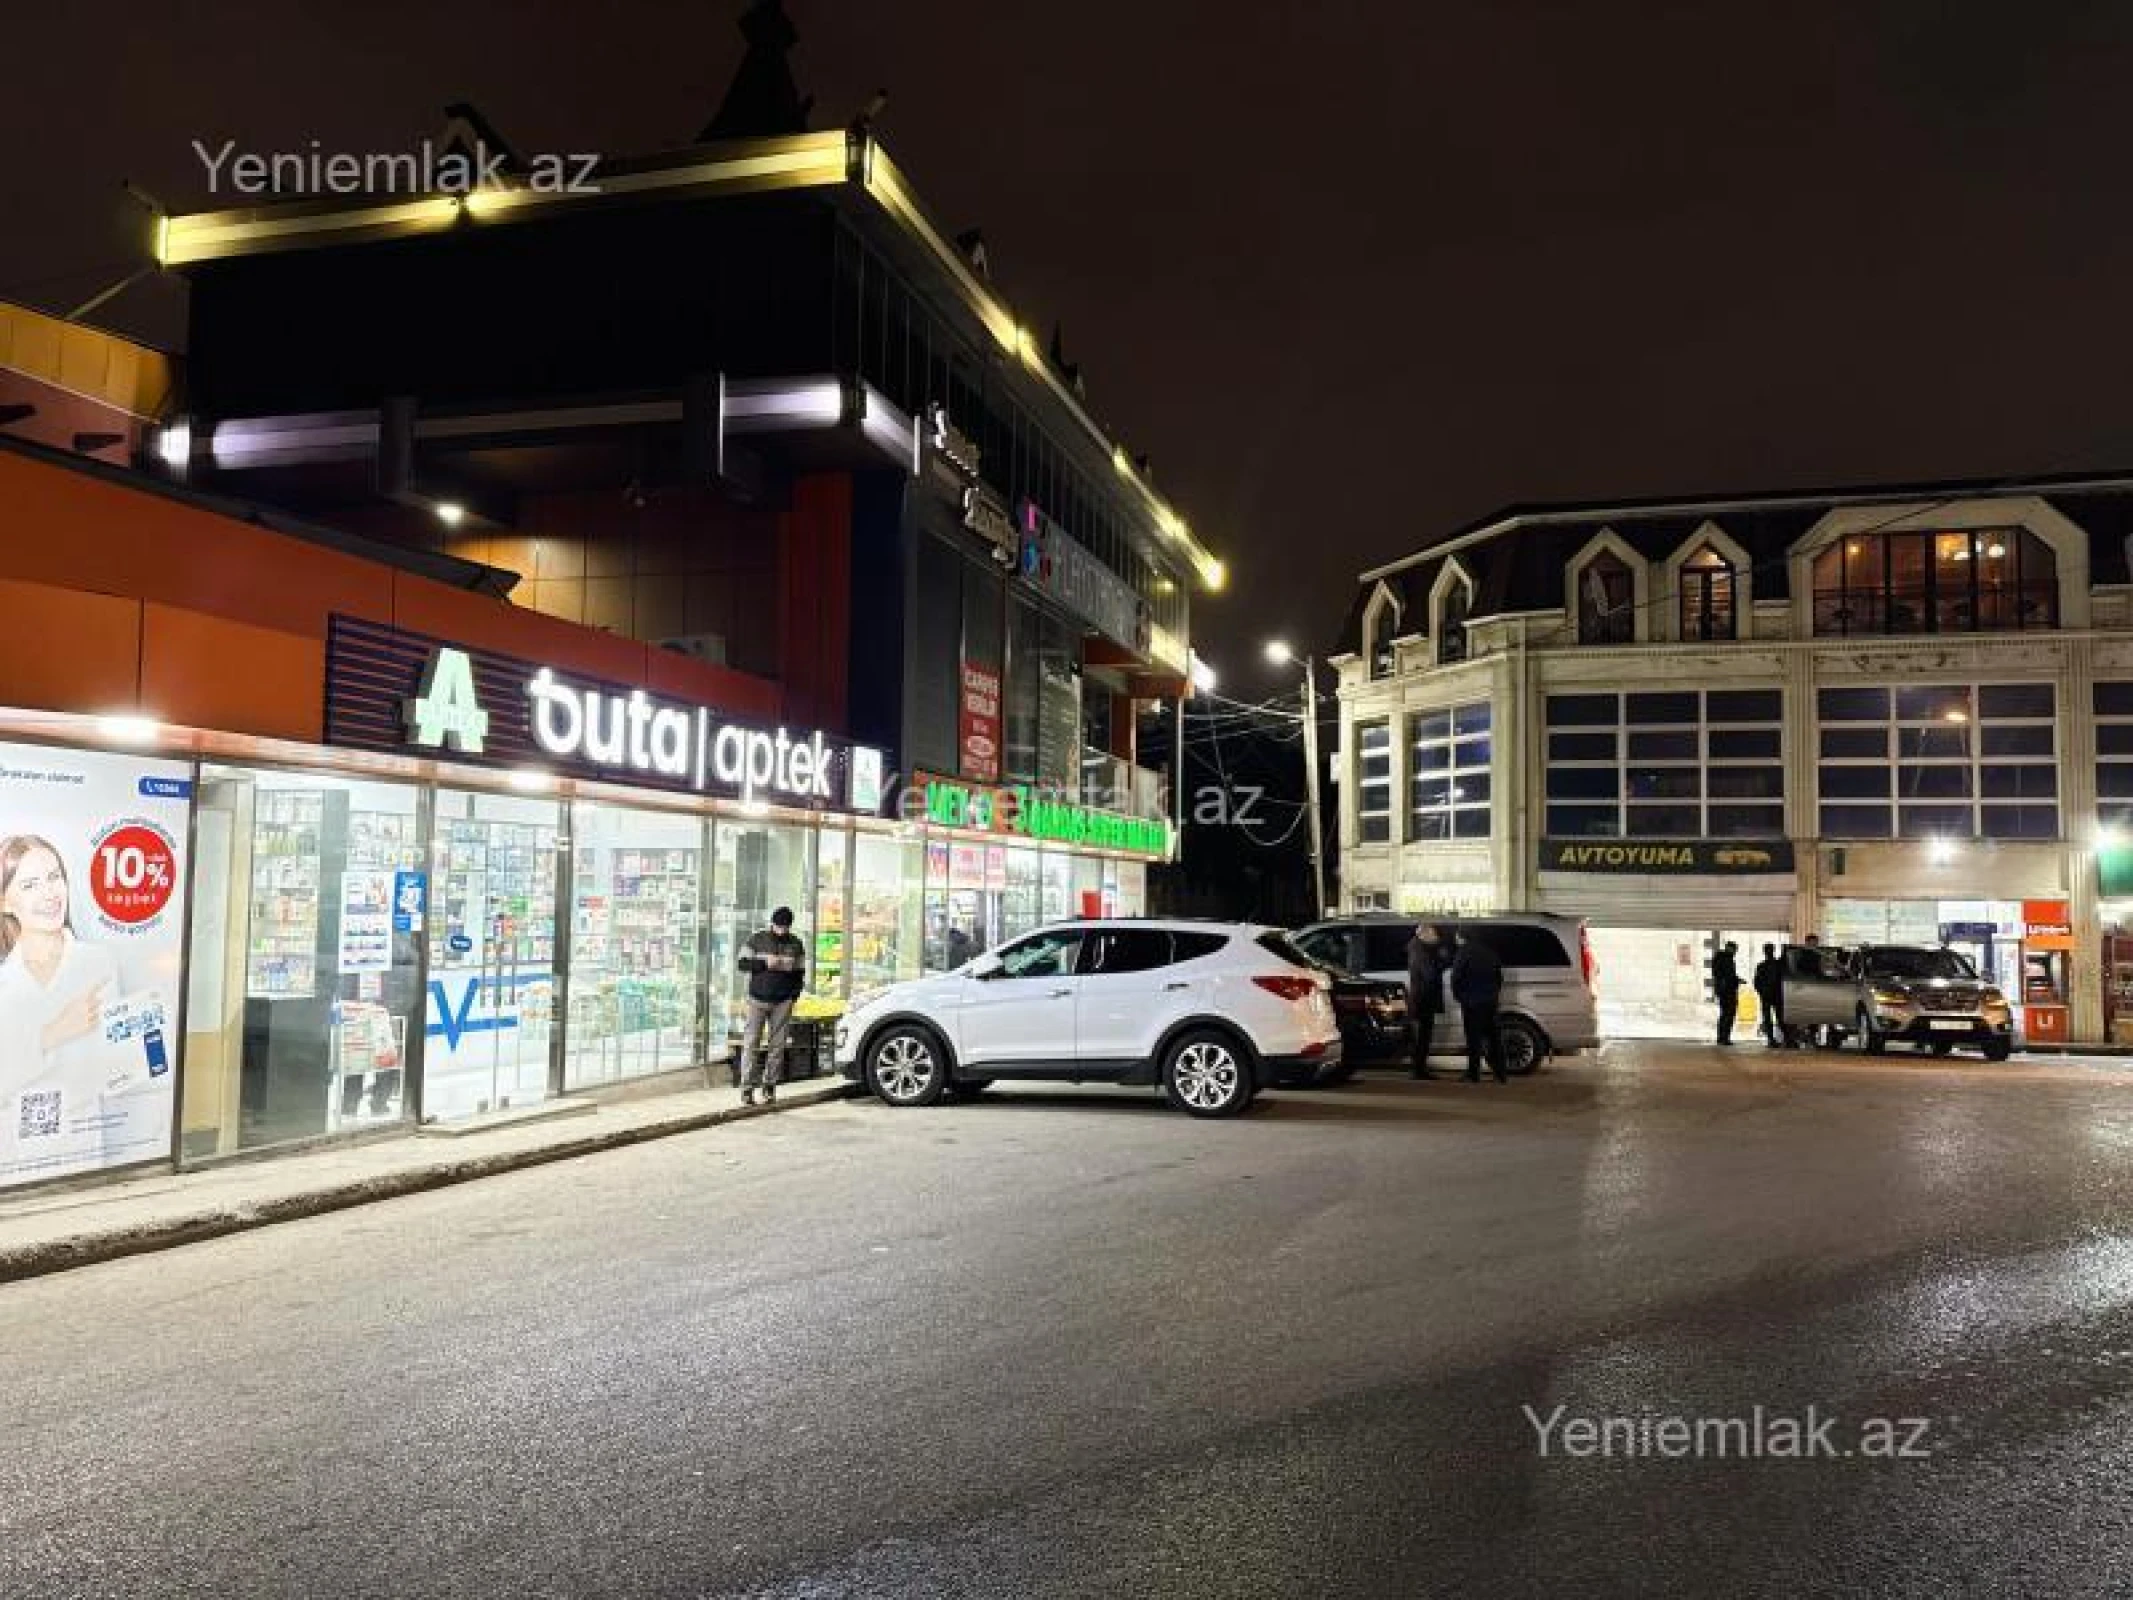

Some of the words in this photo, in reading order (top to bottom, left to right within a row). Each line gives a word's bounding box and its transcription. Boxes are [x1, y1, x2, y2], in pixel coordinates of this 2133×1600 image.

[528, 666, 690, 776] buta
[714, 724, 833, 807] aptek
[100, 846, 169, 889] 10%
[1558, 846, 1695, 866] AVTOYUMA
